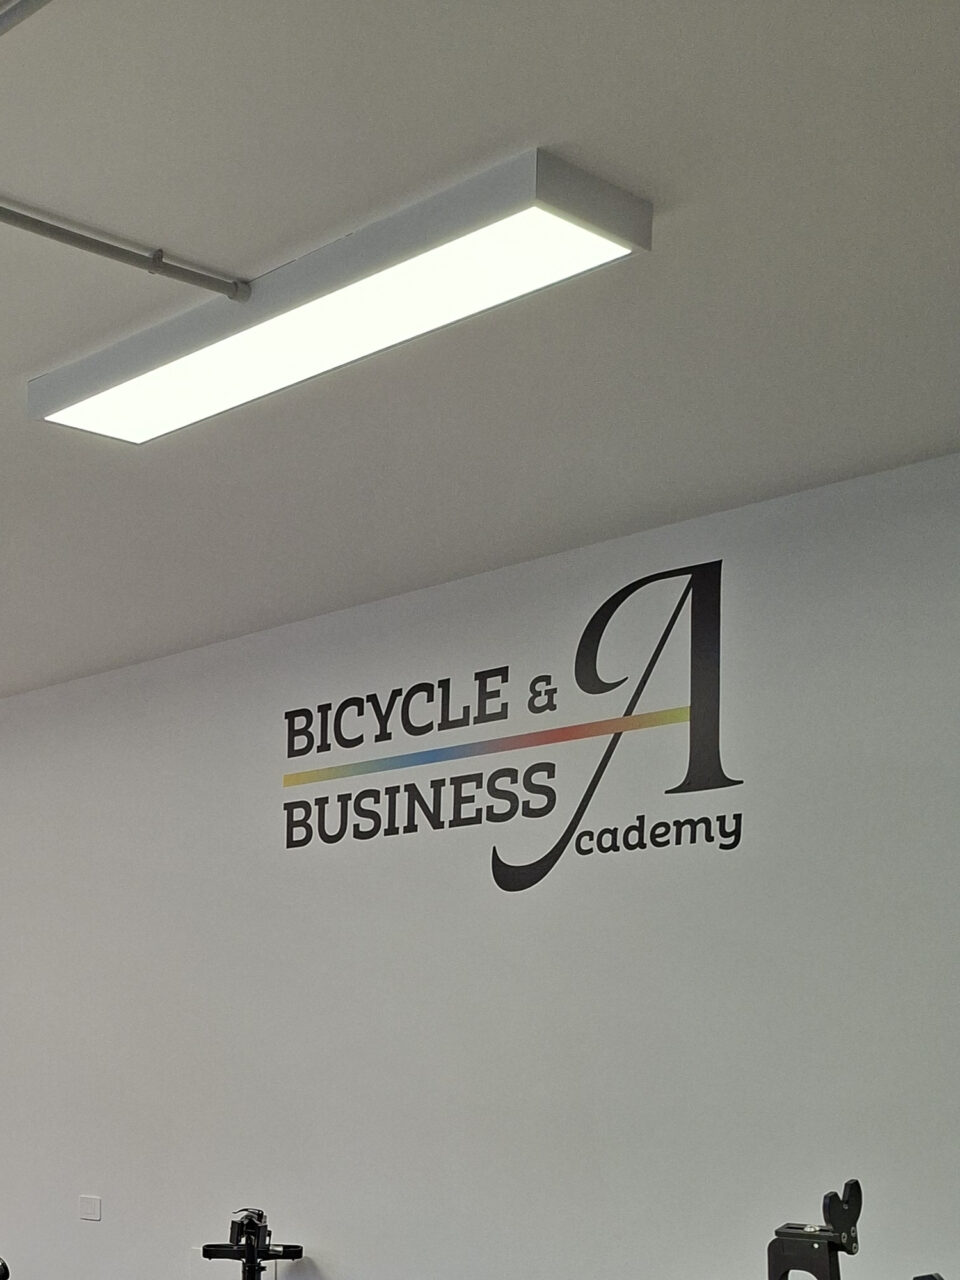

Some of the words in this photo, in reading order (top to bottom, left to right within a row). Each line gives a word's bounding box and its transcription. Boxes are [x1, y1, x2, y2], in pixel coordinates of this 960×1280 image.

[284, 666, 510, 758] BICYCLE
[527, 674, 558, 714] &
[283, 762, 557, 850] BUSINESS
